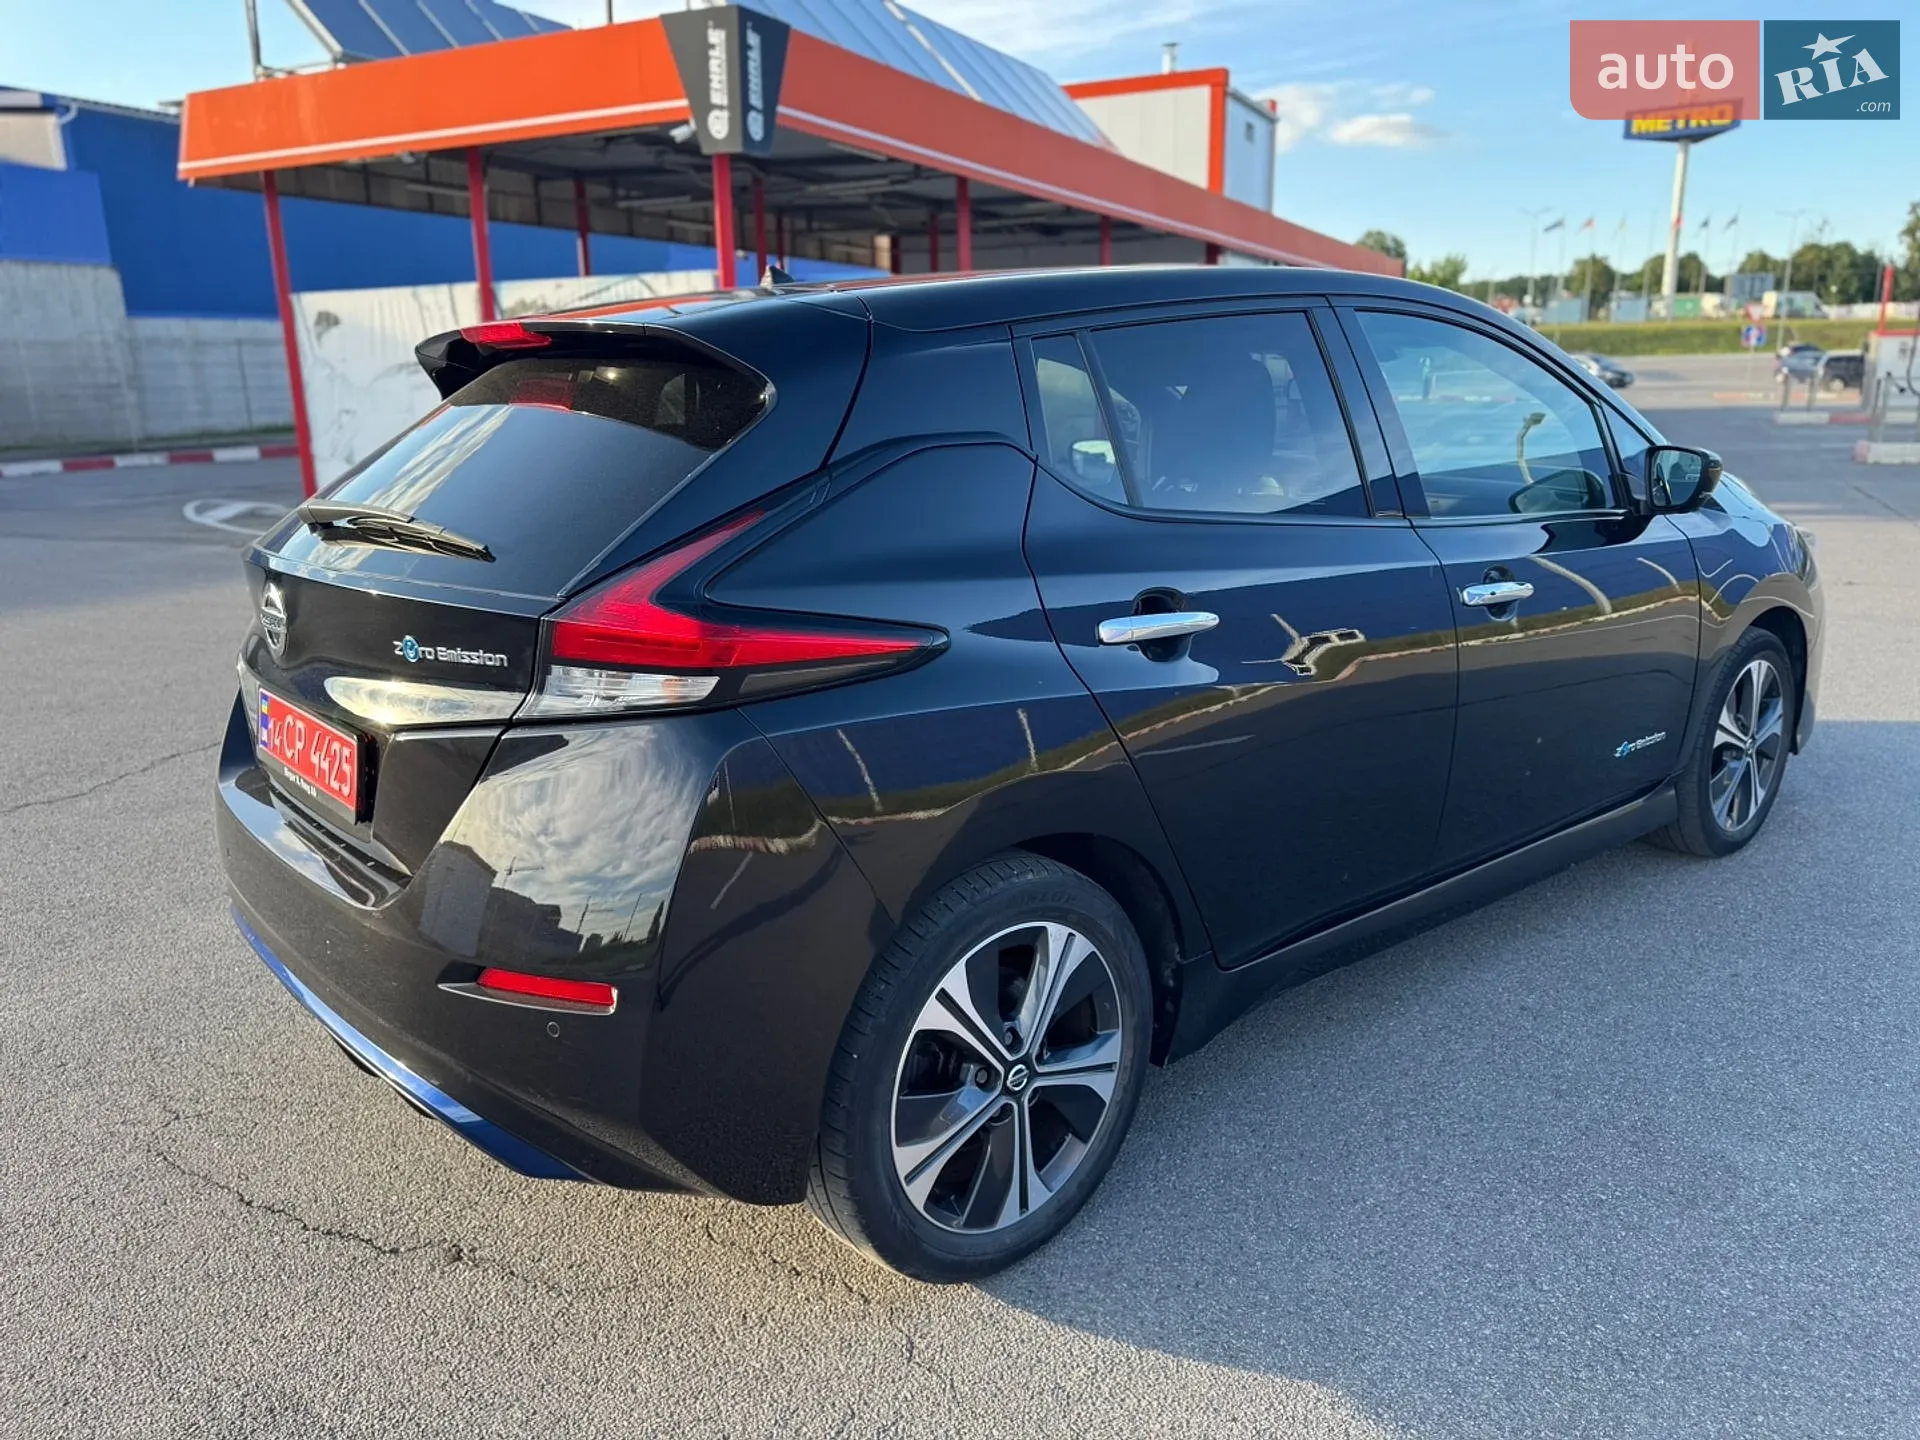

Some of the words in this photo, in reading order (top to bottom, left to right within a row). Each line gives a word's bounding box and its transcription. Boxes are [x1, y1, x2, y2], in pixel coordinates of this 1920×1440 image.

[1631, 102, 1735, 136] METRO
[436, 646, 508, 667] Emission
[310, 730, 353, 797] 4425
